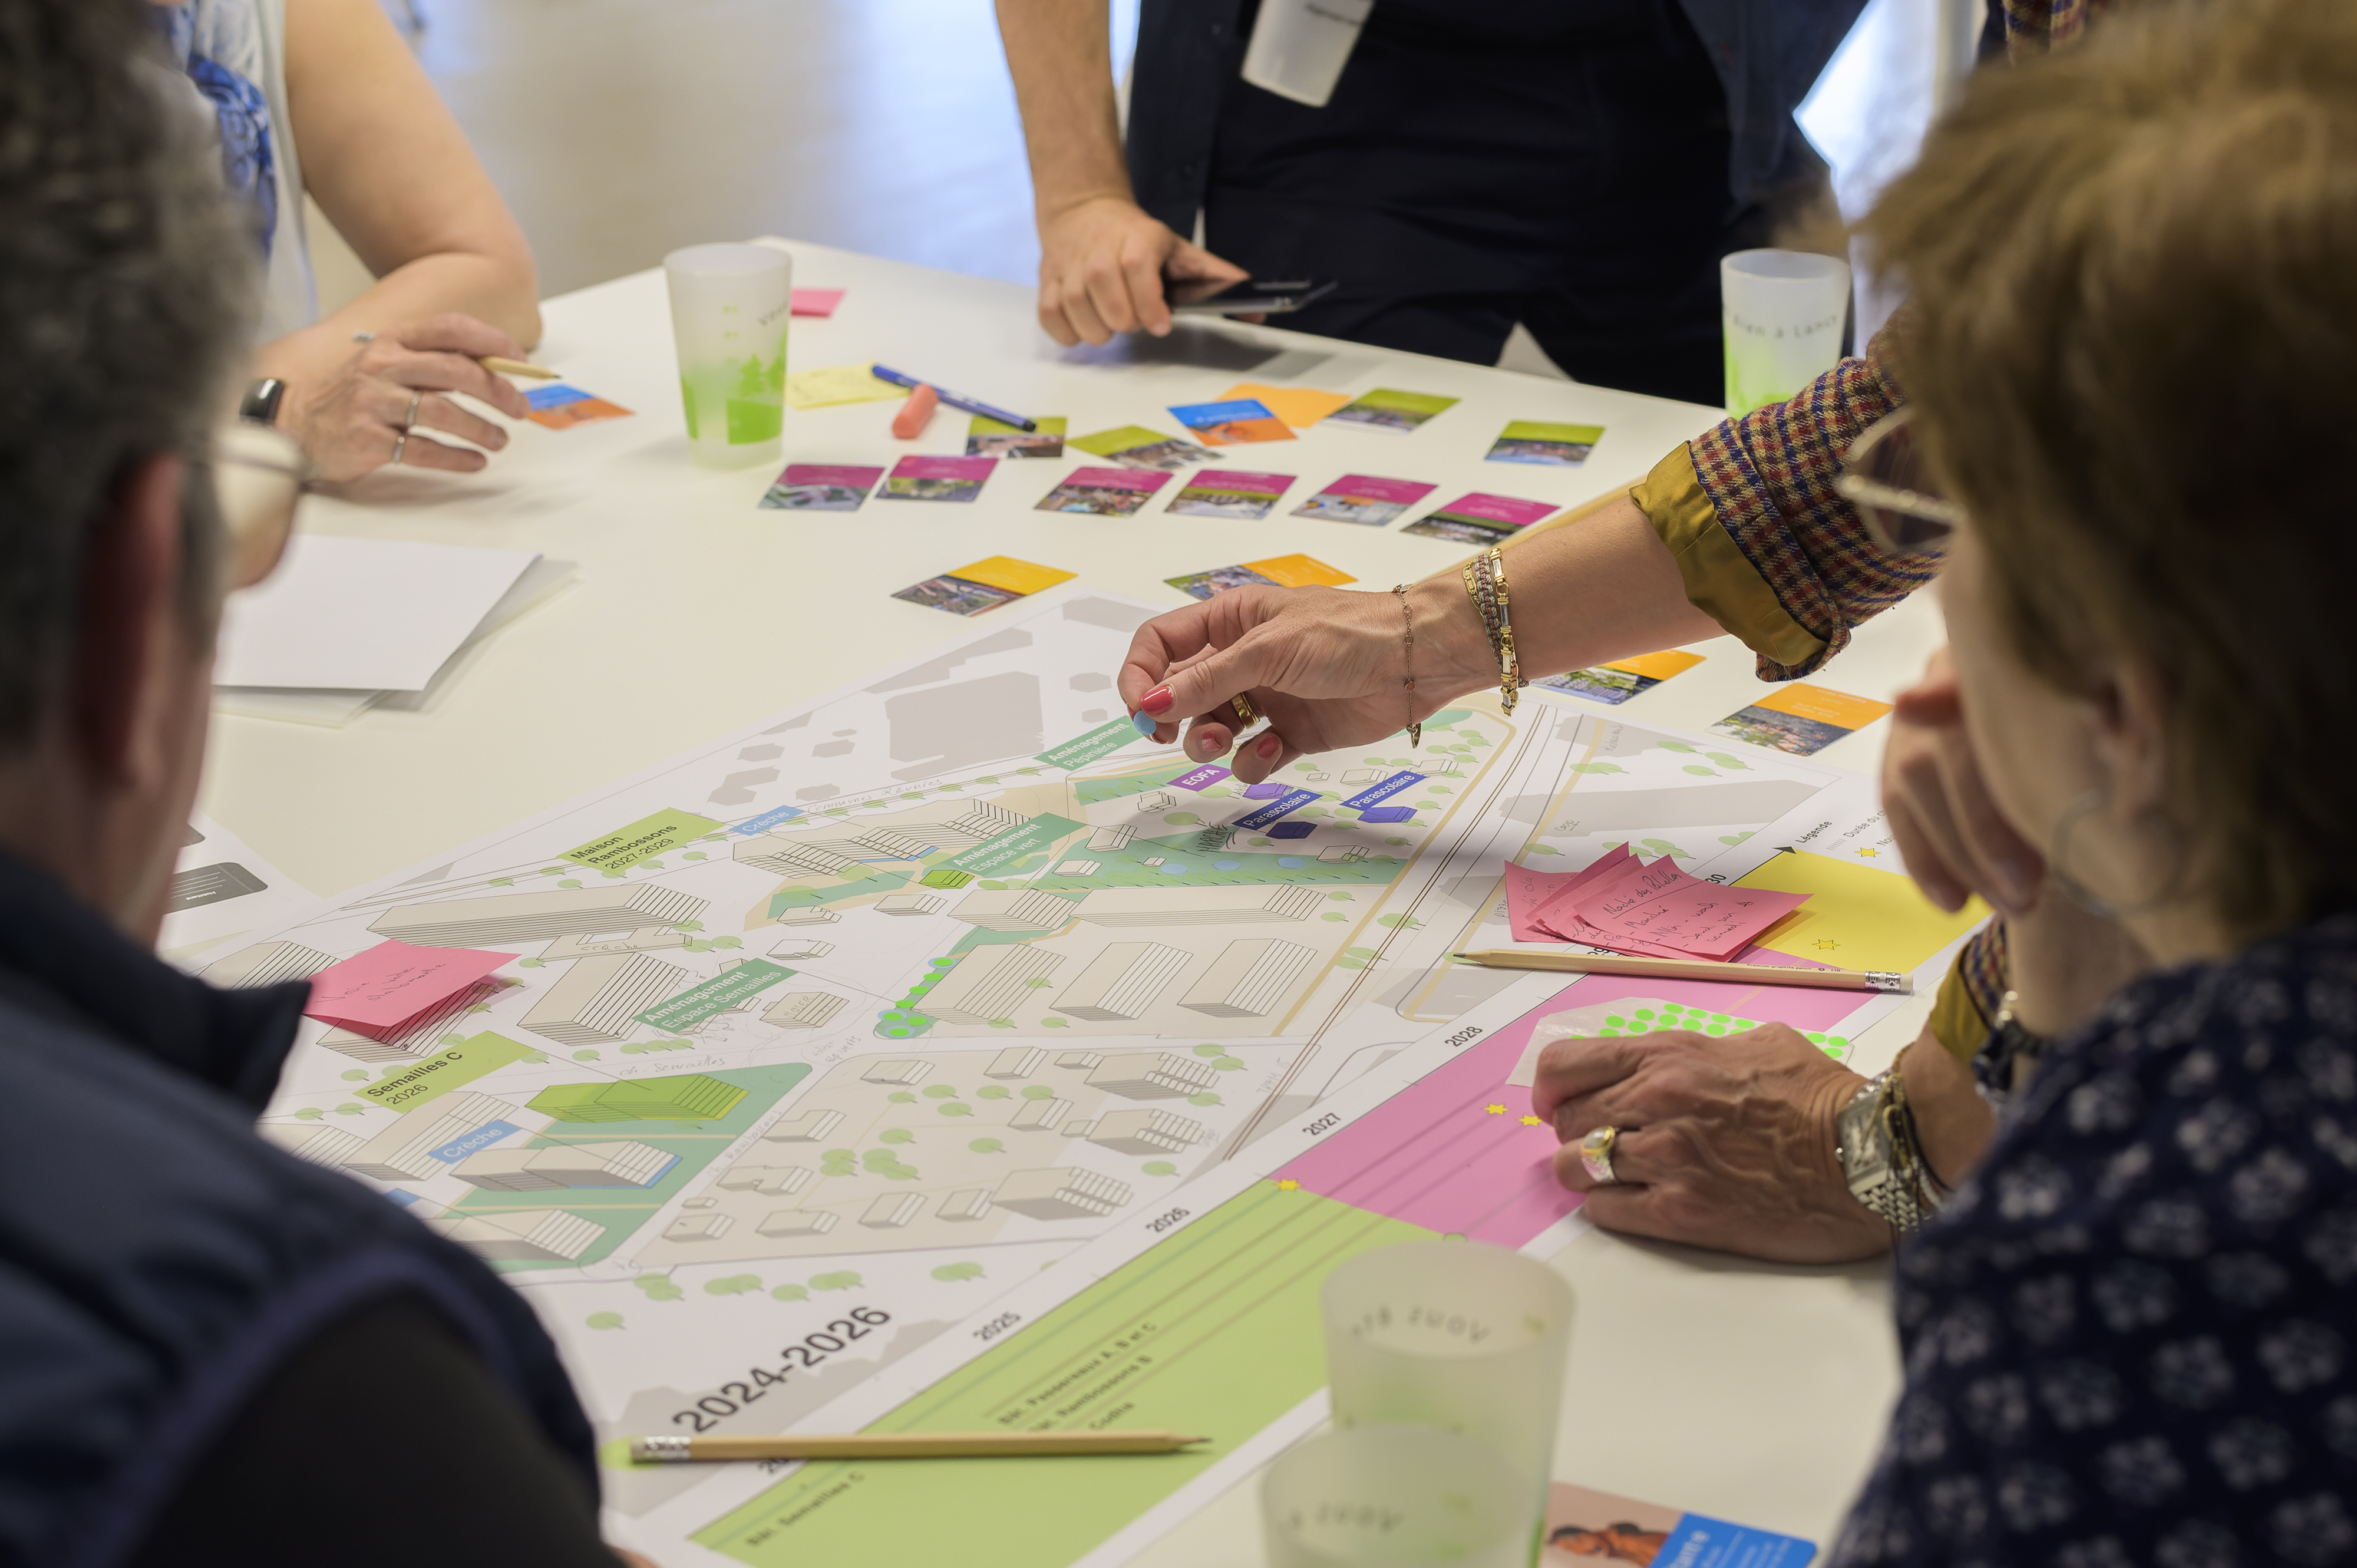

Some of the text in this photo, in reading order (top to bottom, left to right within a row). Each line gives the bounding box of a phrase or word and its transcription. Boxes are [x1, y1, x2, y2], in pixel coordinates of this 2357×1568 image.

[1048, 722, 1130, 761] Aménagement
[1063, 742, 1117, 767] Pépinière
[1181, 769, 1220, 786] EOFA
[1349, 773, 1415, 808] Parascolaire
[743, 811, 789, 831] Crèche
[1242, 793, 1311, 827] Parascolaire
[587, 825, 677, 863] Rambossons
[953, 823, 1042, 866] Aménagement
[1795, 821, 1832, 843] Légende
[1843, 823, 1870, 837] Durée
[570, 836, 623, 859] Maison
[605, 839, 674, 869] 2027-2029
[969, 838, 1041, 872] Espace vert
[645, 970, 749, 1022] Aménagement
[661, 970, 781, 1029] Espace Semailles
[1444, 1026, 1483, 1048] 2028
[367, 1060, 448, 1097] Semailles
[387, 1084, 428, 1104] 2026
[1302, 1112, 1342, 1137] 2027
[443, 1128, 502, 1157] Crèche
[1146, 1206, 1190, 1234] 2026
[972, 1312, 1021, 1341] 2025
[672, 1306, 890, 1432] 2024-2026
